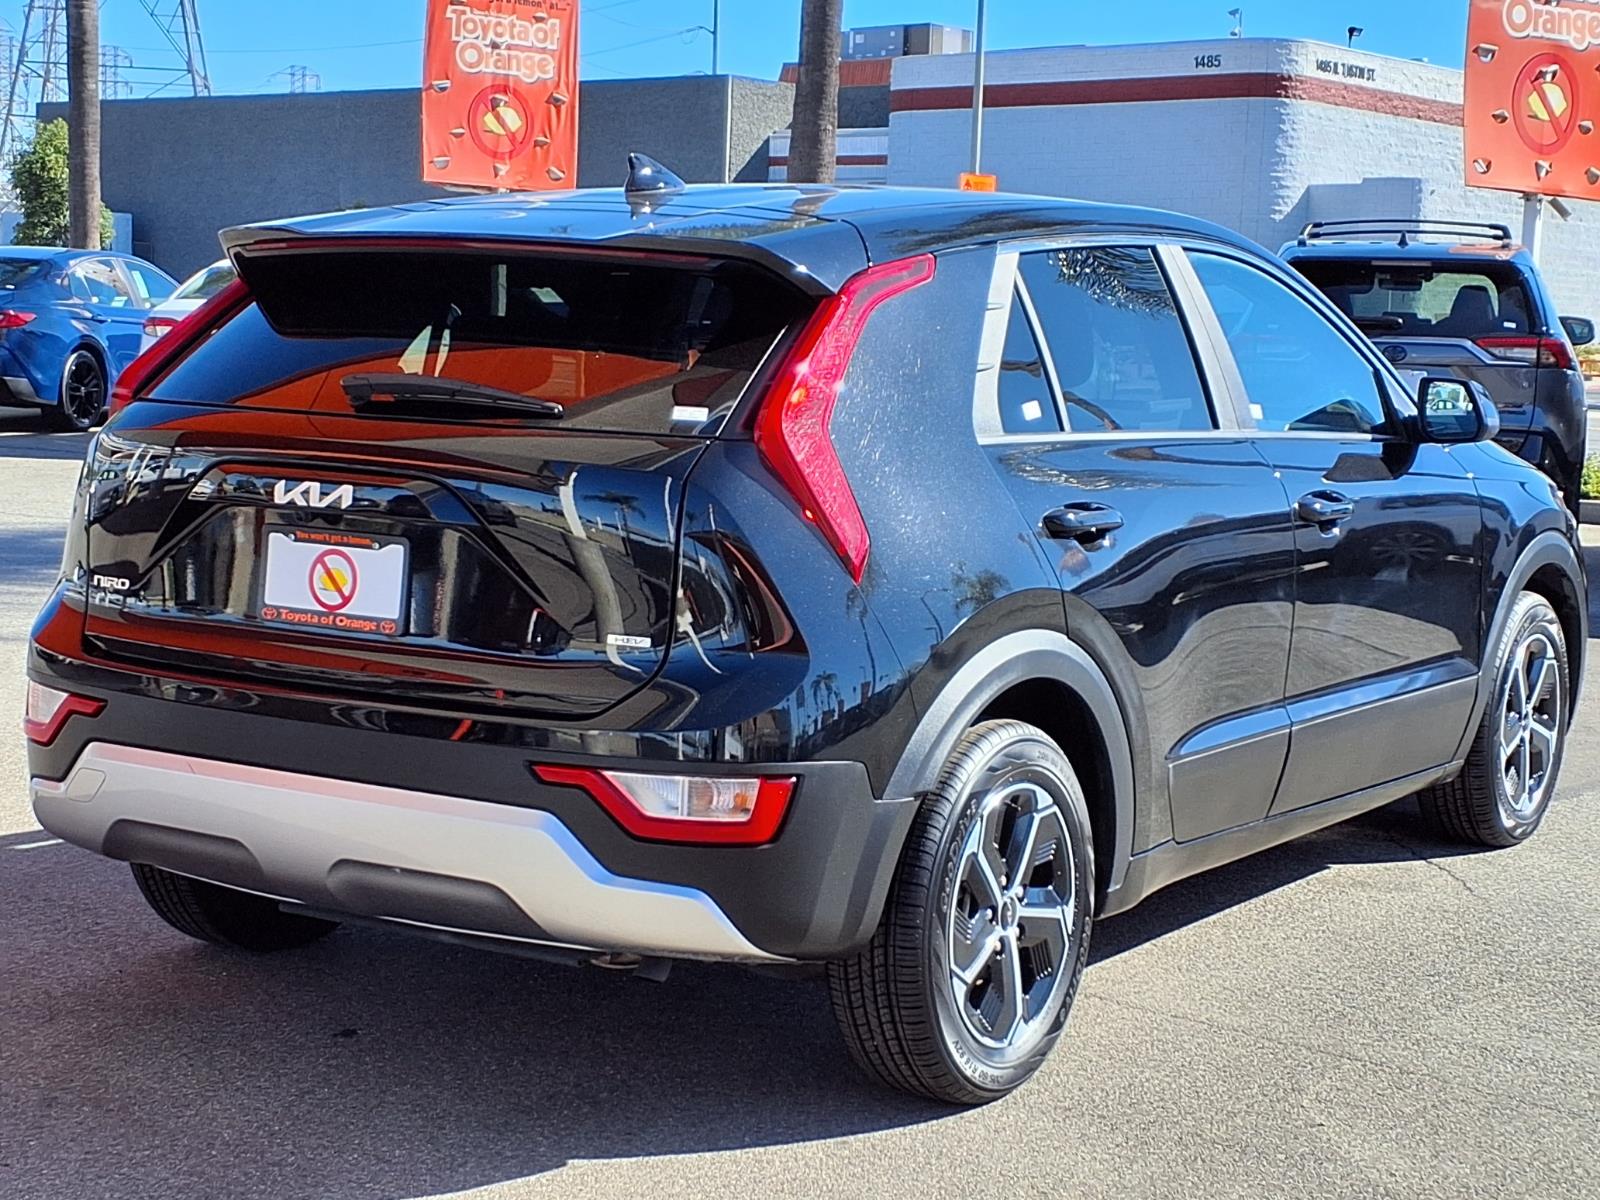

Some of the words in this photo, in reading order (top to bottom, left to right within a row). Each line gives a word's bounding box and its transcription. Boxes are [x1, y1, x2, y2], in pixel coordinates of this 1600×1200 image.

[446, 6, 532, 46] Toyota
[533, 19, 560, 49] of
[1503, 0, 1600, 50] Orange
[456, 39, 554, 83] Orange
[1194, 55, 1222, 69] 1485
[1316, 59, 1332, 73] 1485
[274, 480, 354, 509] KIA
[93, 574, 130, 590] NIRO
[279, 608, 318, 624] Toyota
[321, 615, 334, 625] of
[335, 616, 378, 631] Orange
